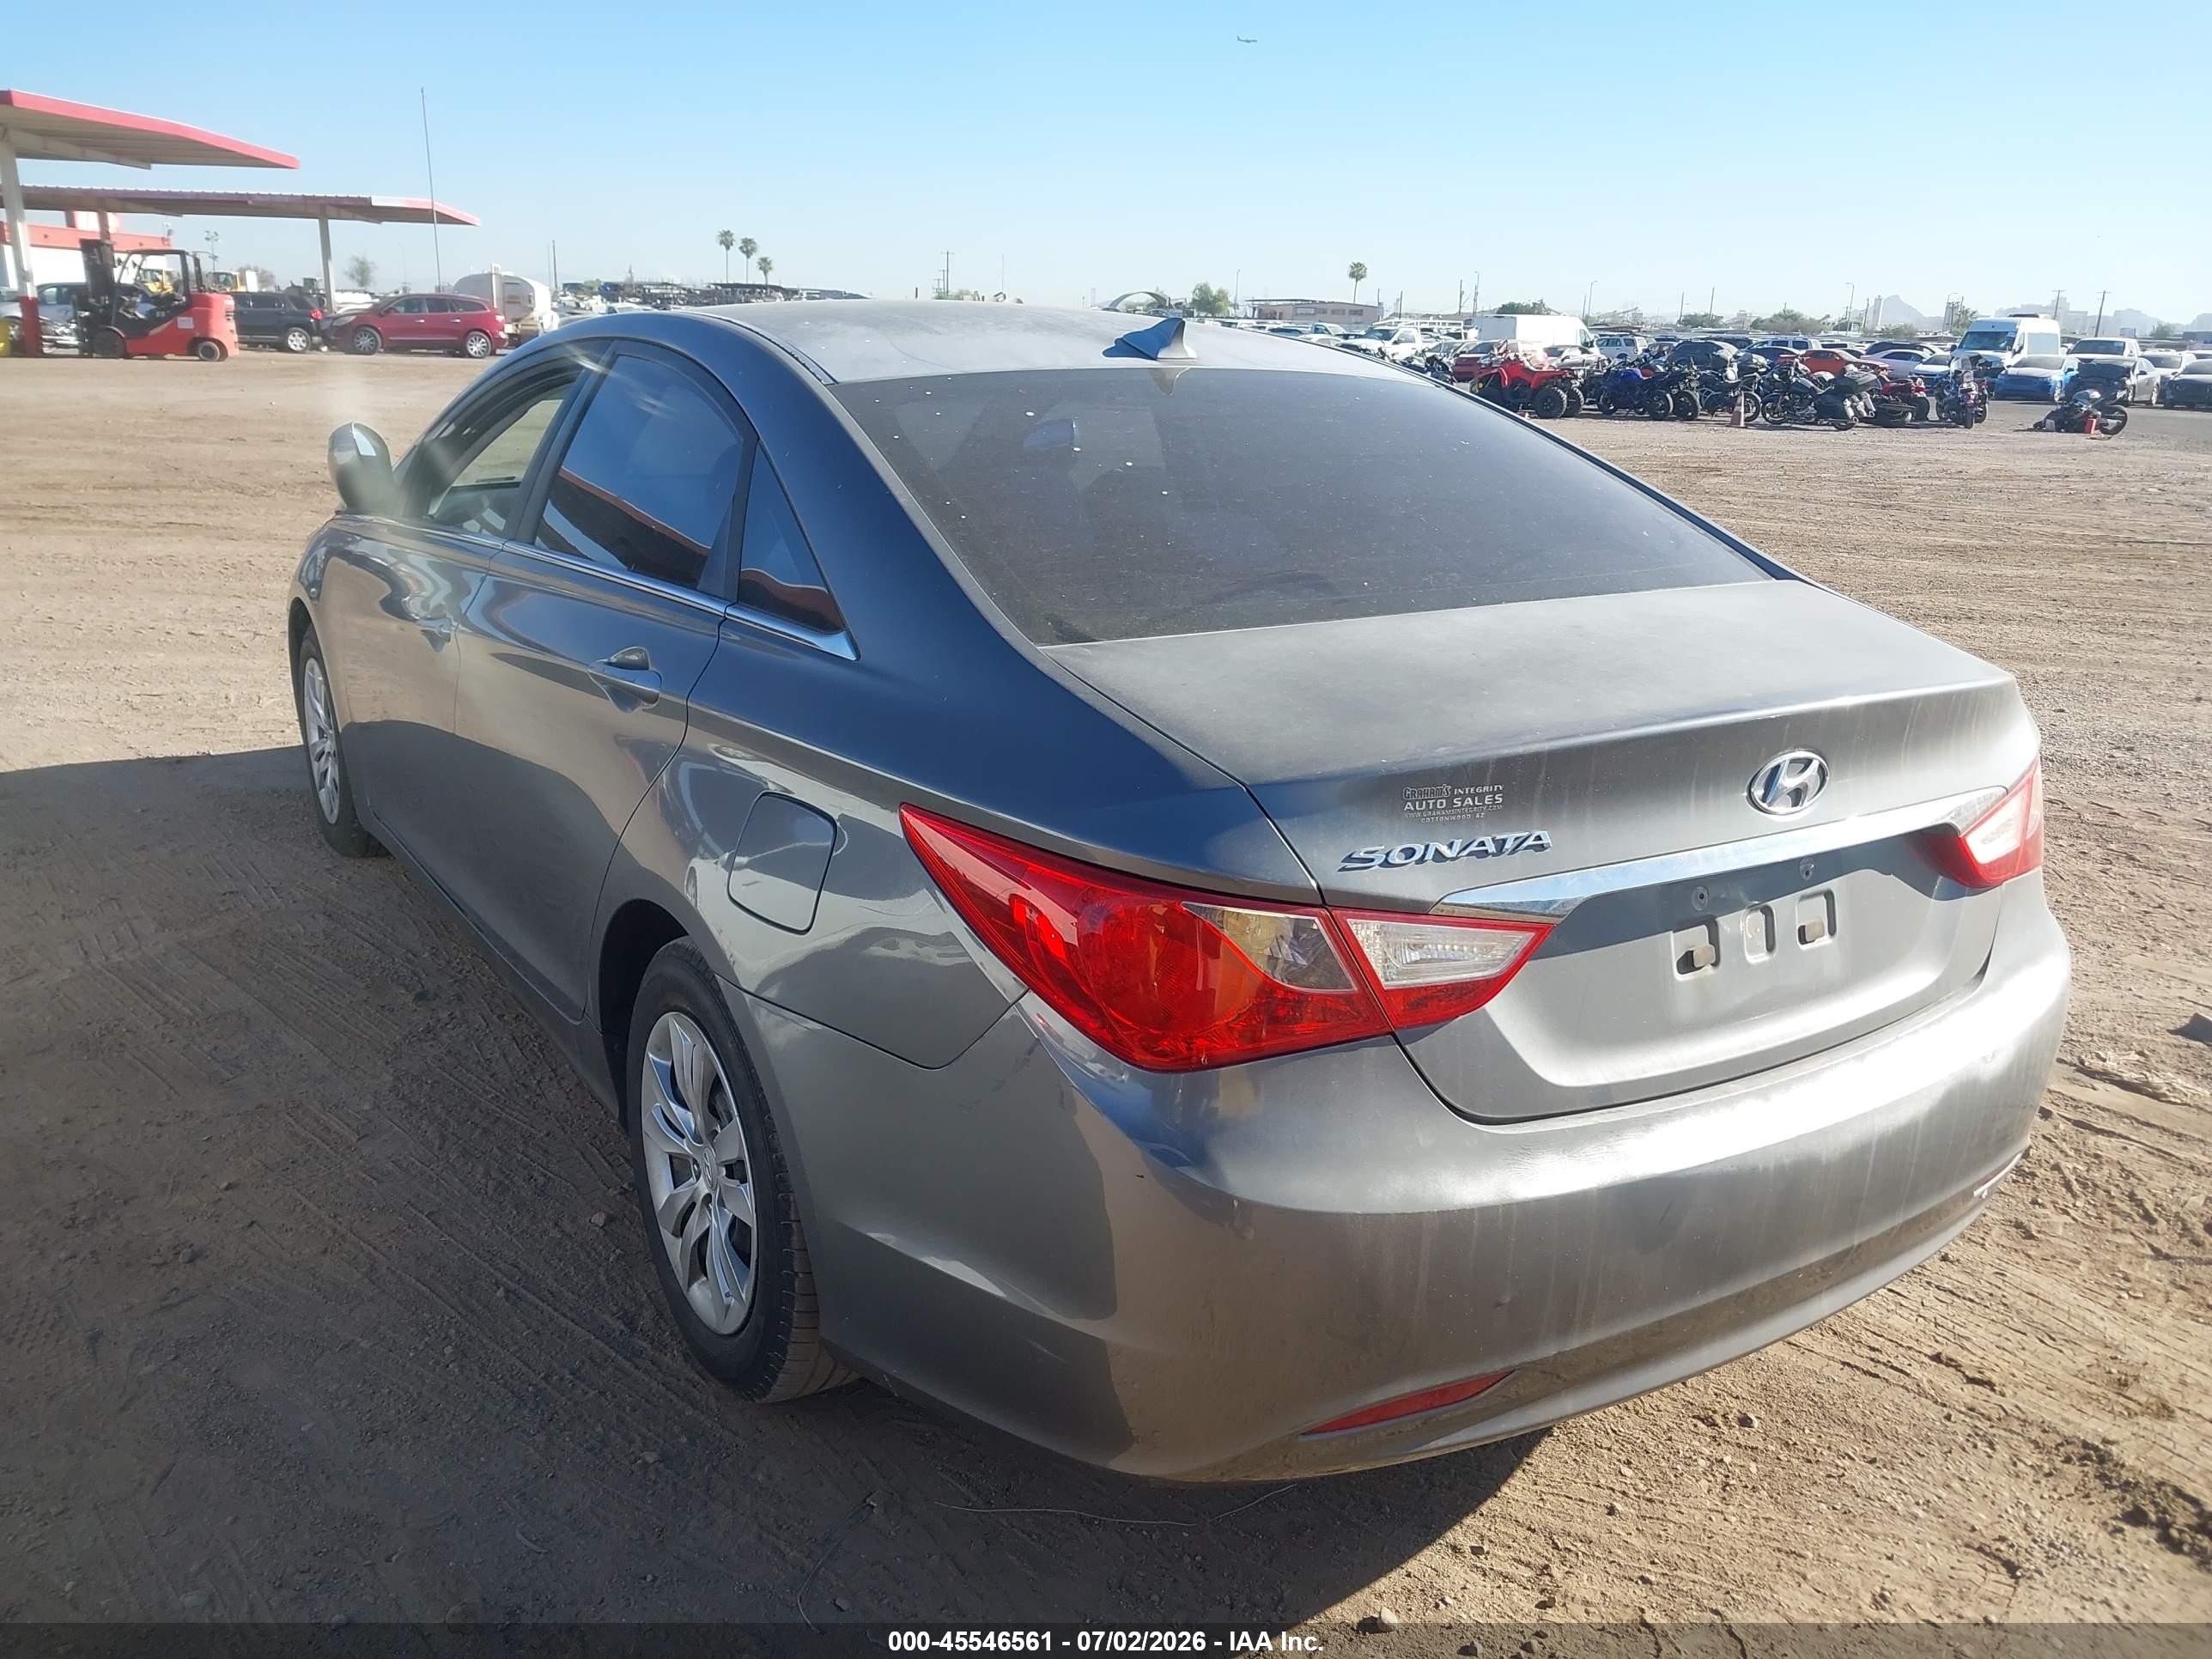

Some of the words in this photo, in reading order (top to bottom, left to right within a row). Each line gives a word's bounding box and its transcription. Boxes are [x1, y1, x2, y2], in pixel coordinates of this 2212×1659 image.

[1454, 785, 1504, 795] INTEGRITY
[1404, 799, 1446, 811] AUTO
[1453, 793, 1503, 807] SALES
[1421, 814, 1471, 823] COTTONWOOD
[1337, 830, 1553, 872] SONATA
